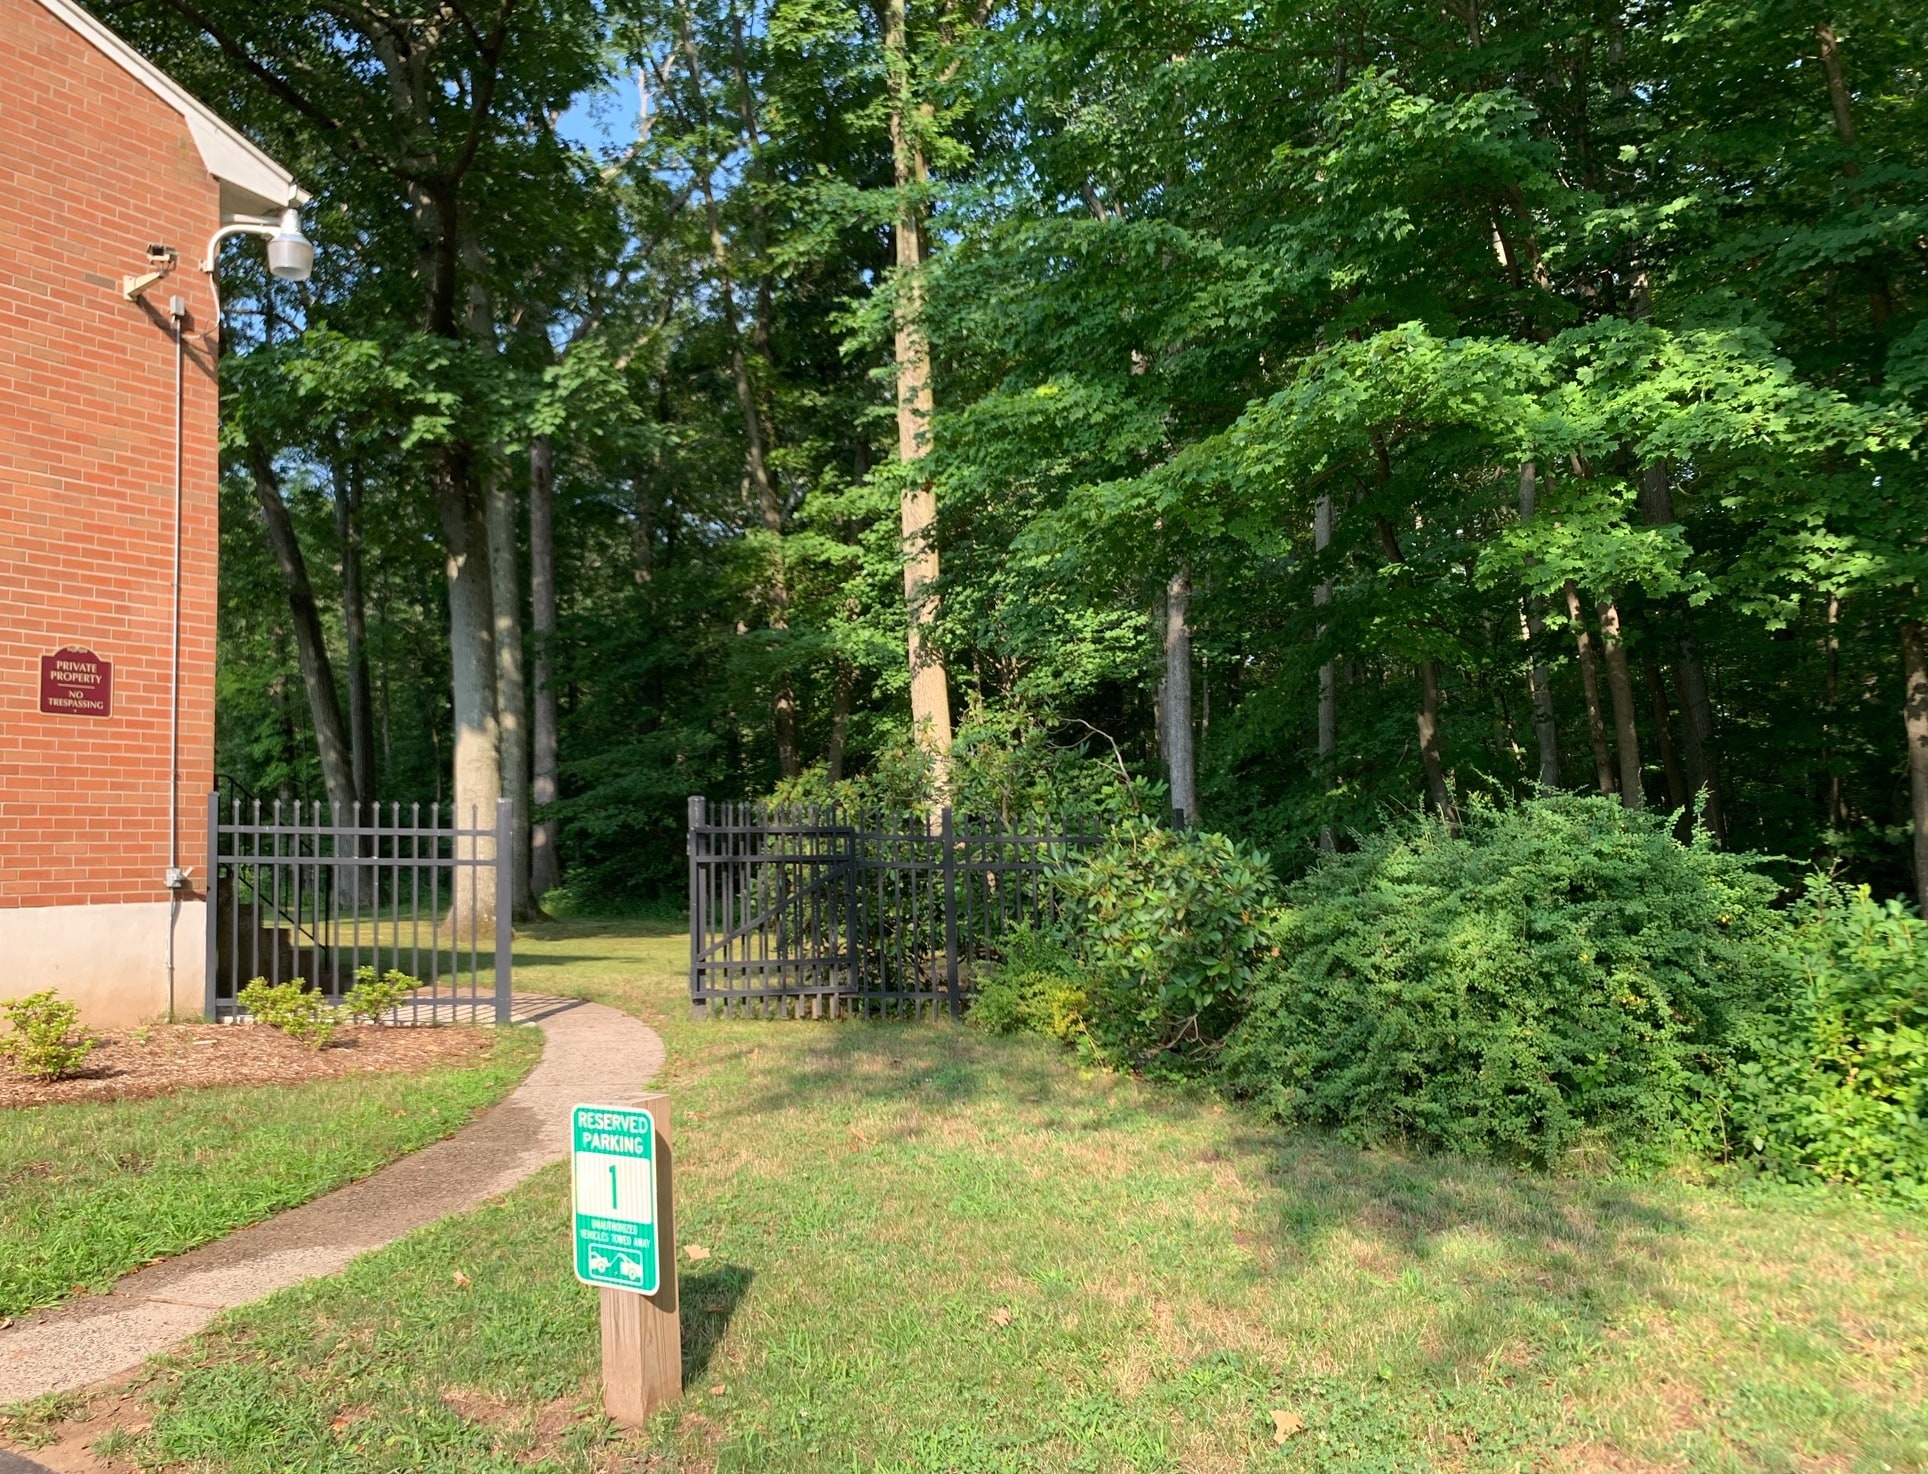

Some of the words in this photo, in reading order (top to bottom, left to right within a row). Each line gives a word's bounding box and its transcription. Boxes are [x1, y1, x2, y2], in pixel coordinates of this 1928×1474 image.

[57, 661, 97, 673] PRIVATE
[51, 671, 102, 684] PROPERTY
[68, 690, 84, 699] NO
[48, 697, 104, 709] TRESPASSING
[578, 1111, 648, 1134] RESERVED
[582, 1132, 643, 1154] PARKING
[609, 1165, 617, 1209] 1
